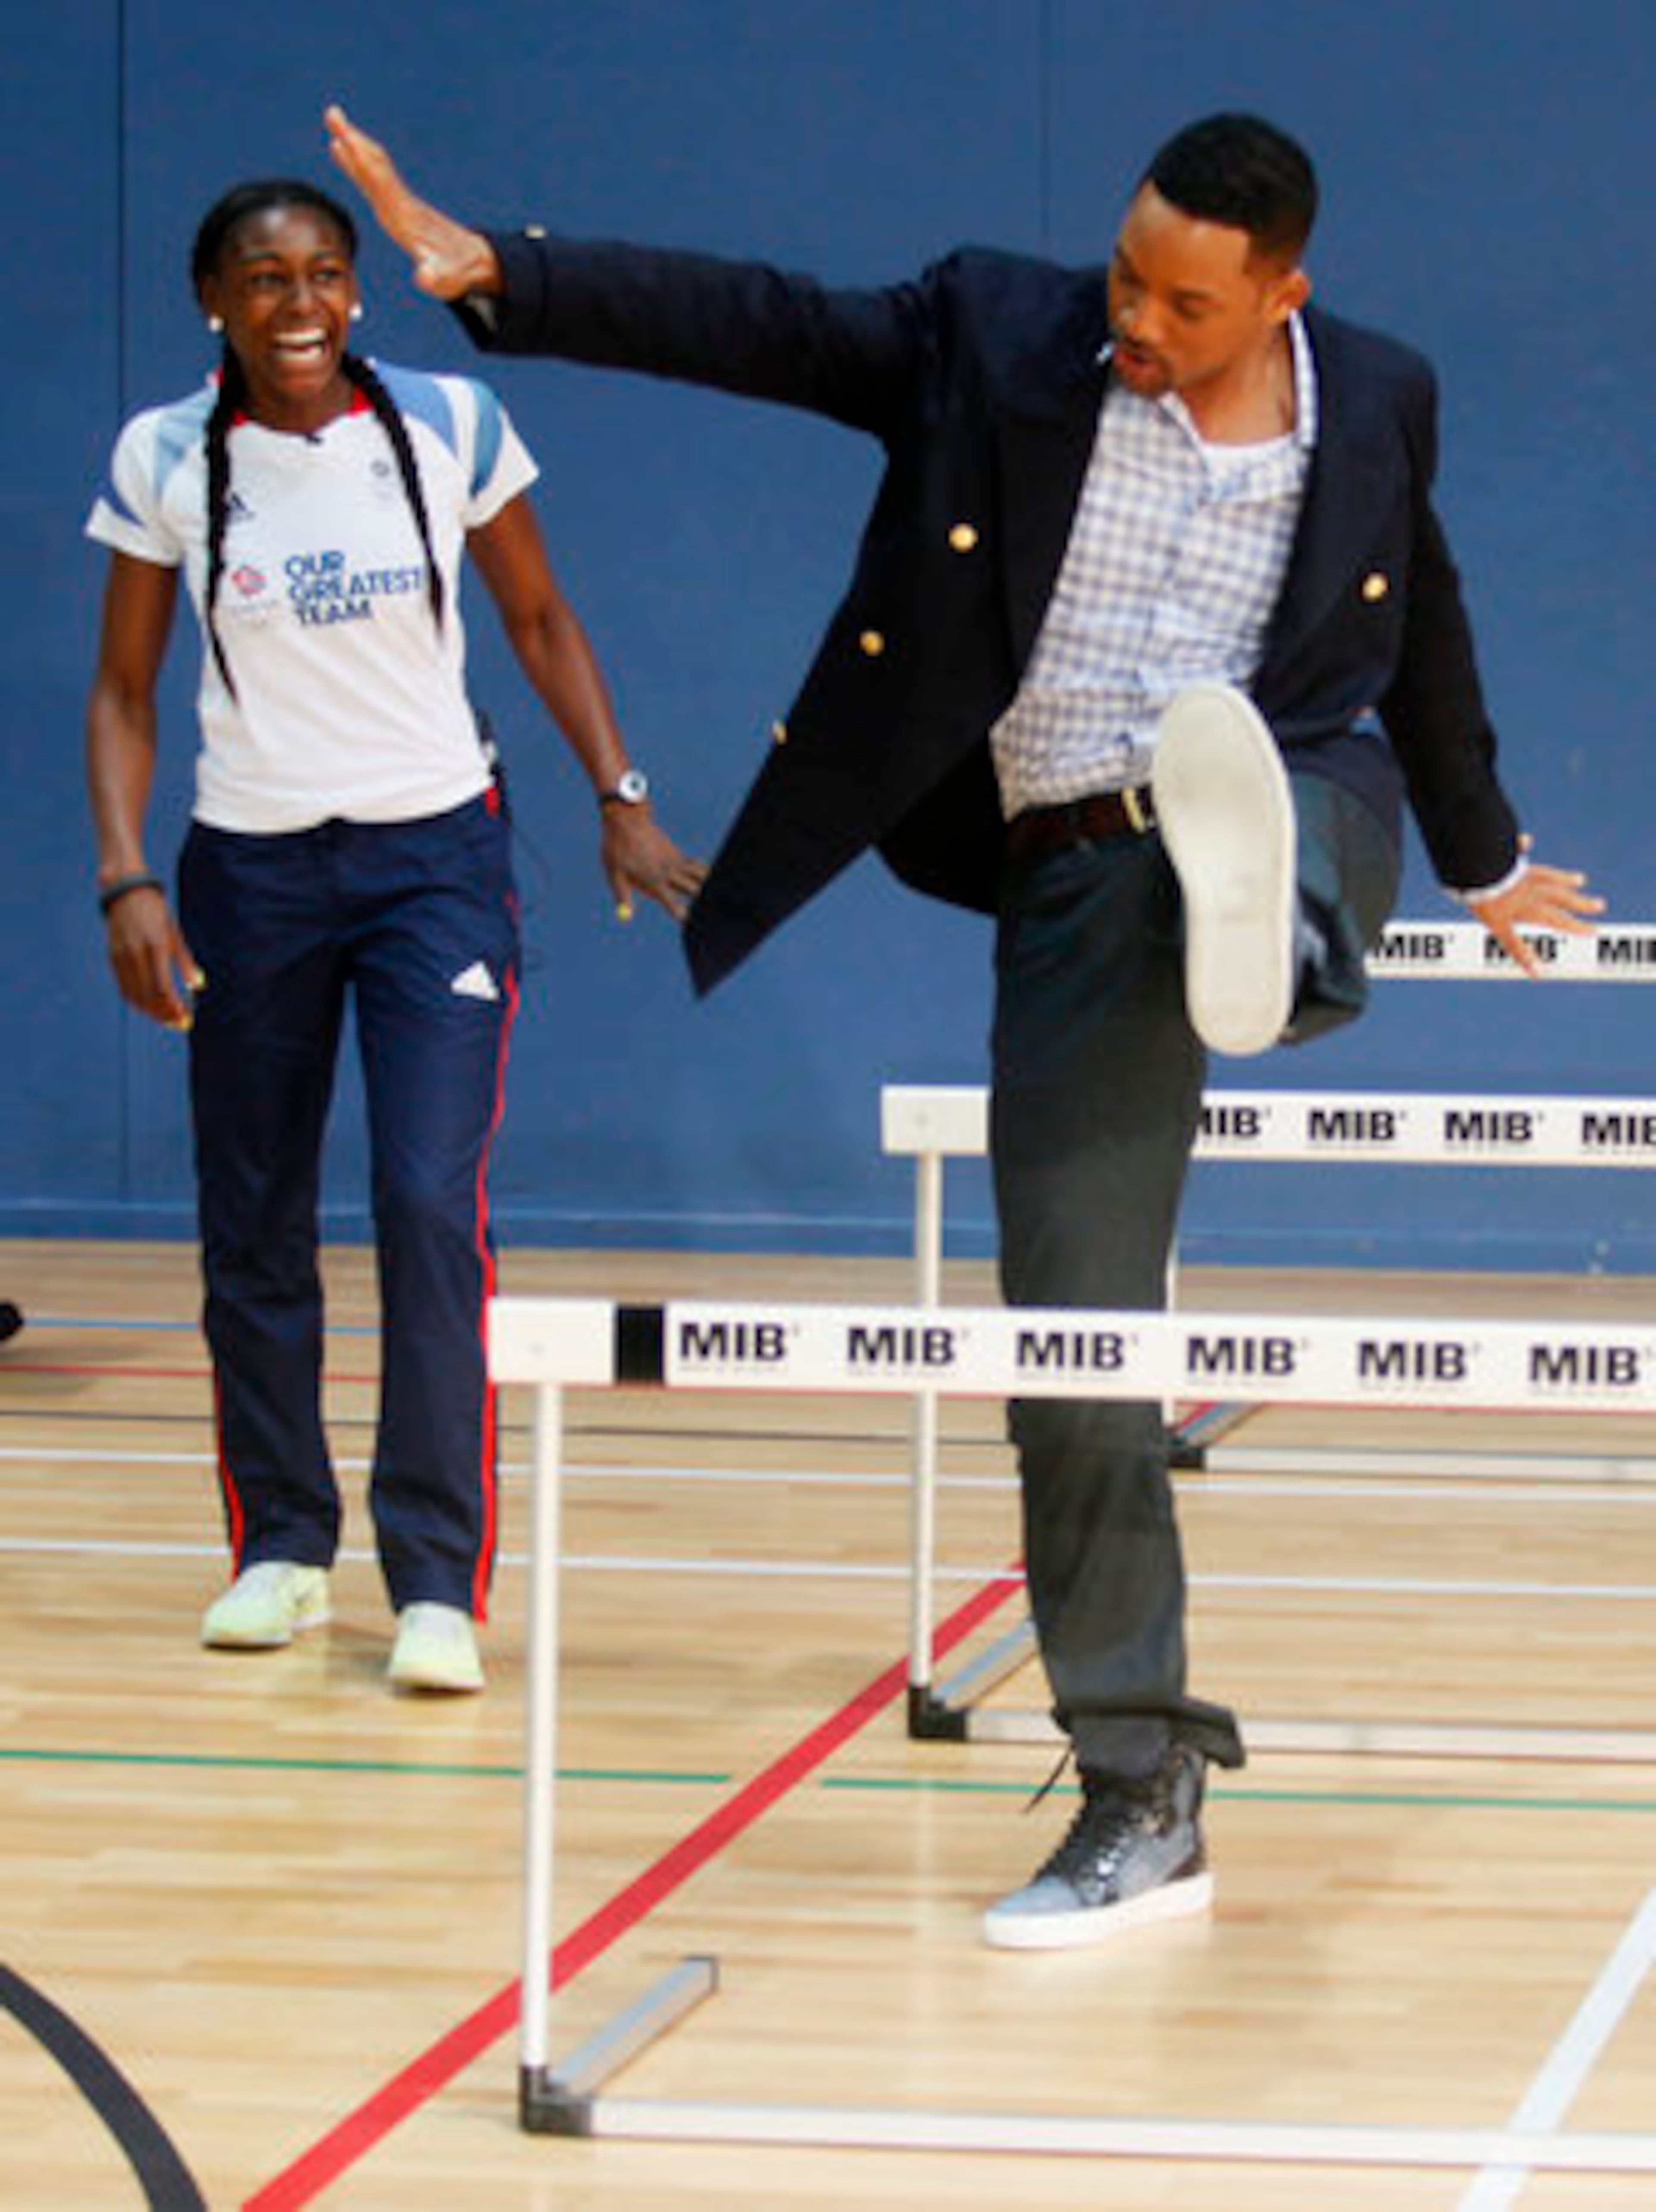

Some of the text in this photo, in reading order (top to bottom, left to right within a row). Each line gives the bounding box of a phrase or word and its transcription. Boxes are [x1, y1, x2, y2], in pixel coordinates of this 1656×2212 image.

[285, 550, 345, 578] OUR
[289, 568, 422, 601] GREATEST
[294, 598, 373, 625] TEAM
[1484, 934, 1558, 963] MB
